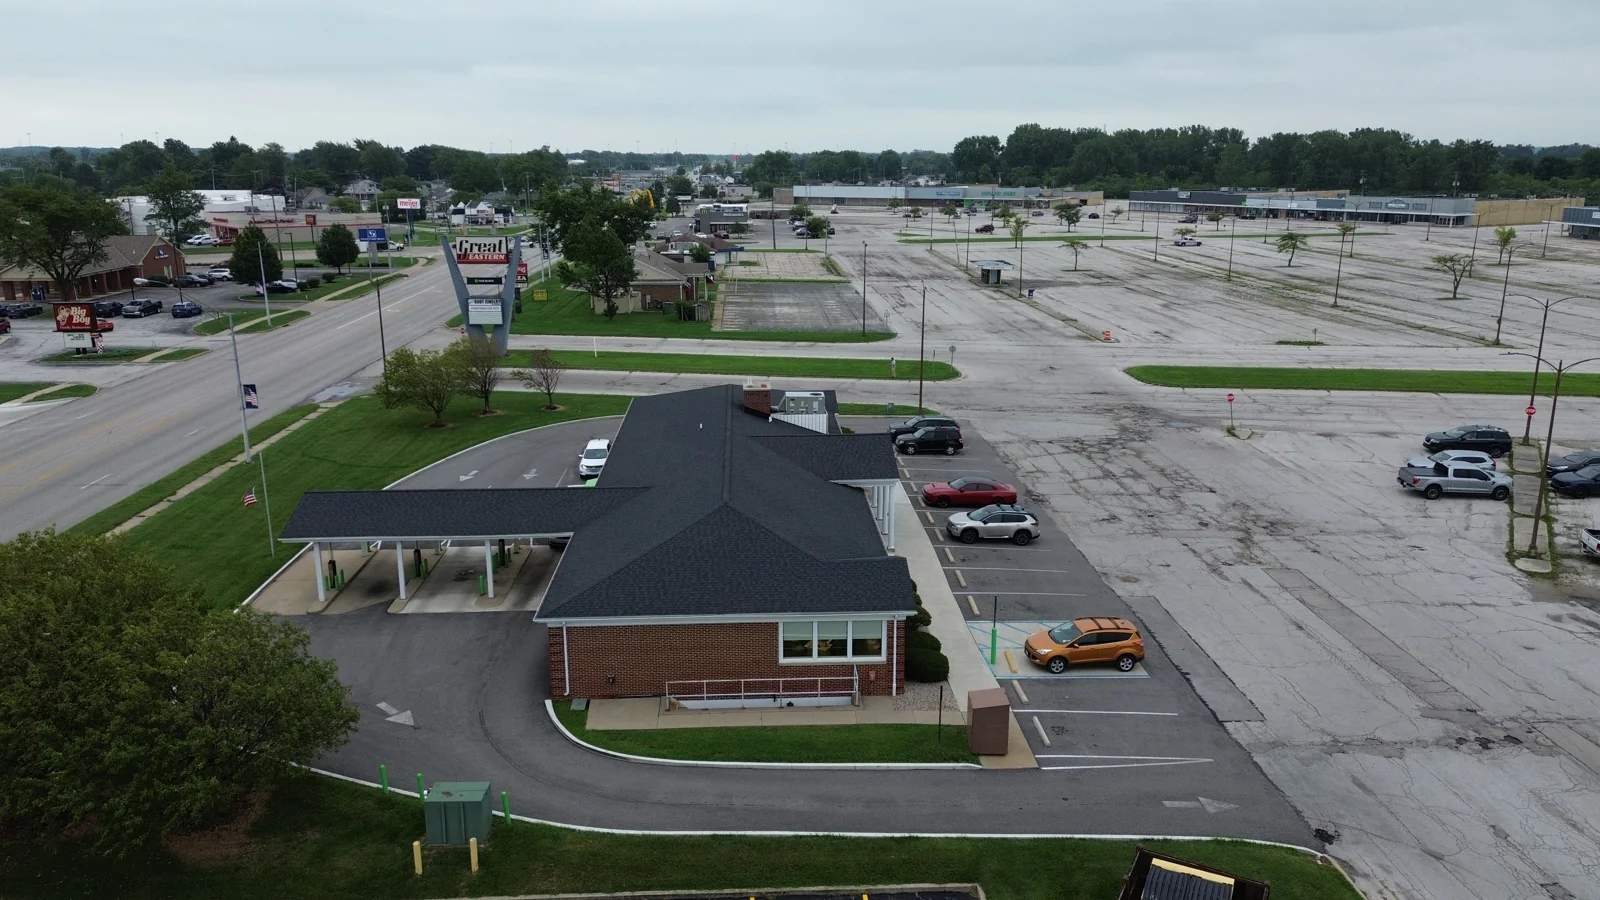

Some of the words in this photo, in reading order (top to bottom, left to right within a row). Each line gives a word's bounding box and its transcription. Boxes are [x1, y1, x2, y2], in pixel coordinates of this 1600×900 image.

[459, 240, 503, 259] Great
[70, 306, 87, 317] Big
[72, 315, 91, 325] Boy
